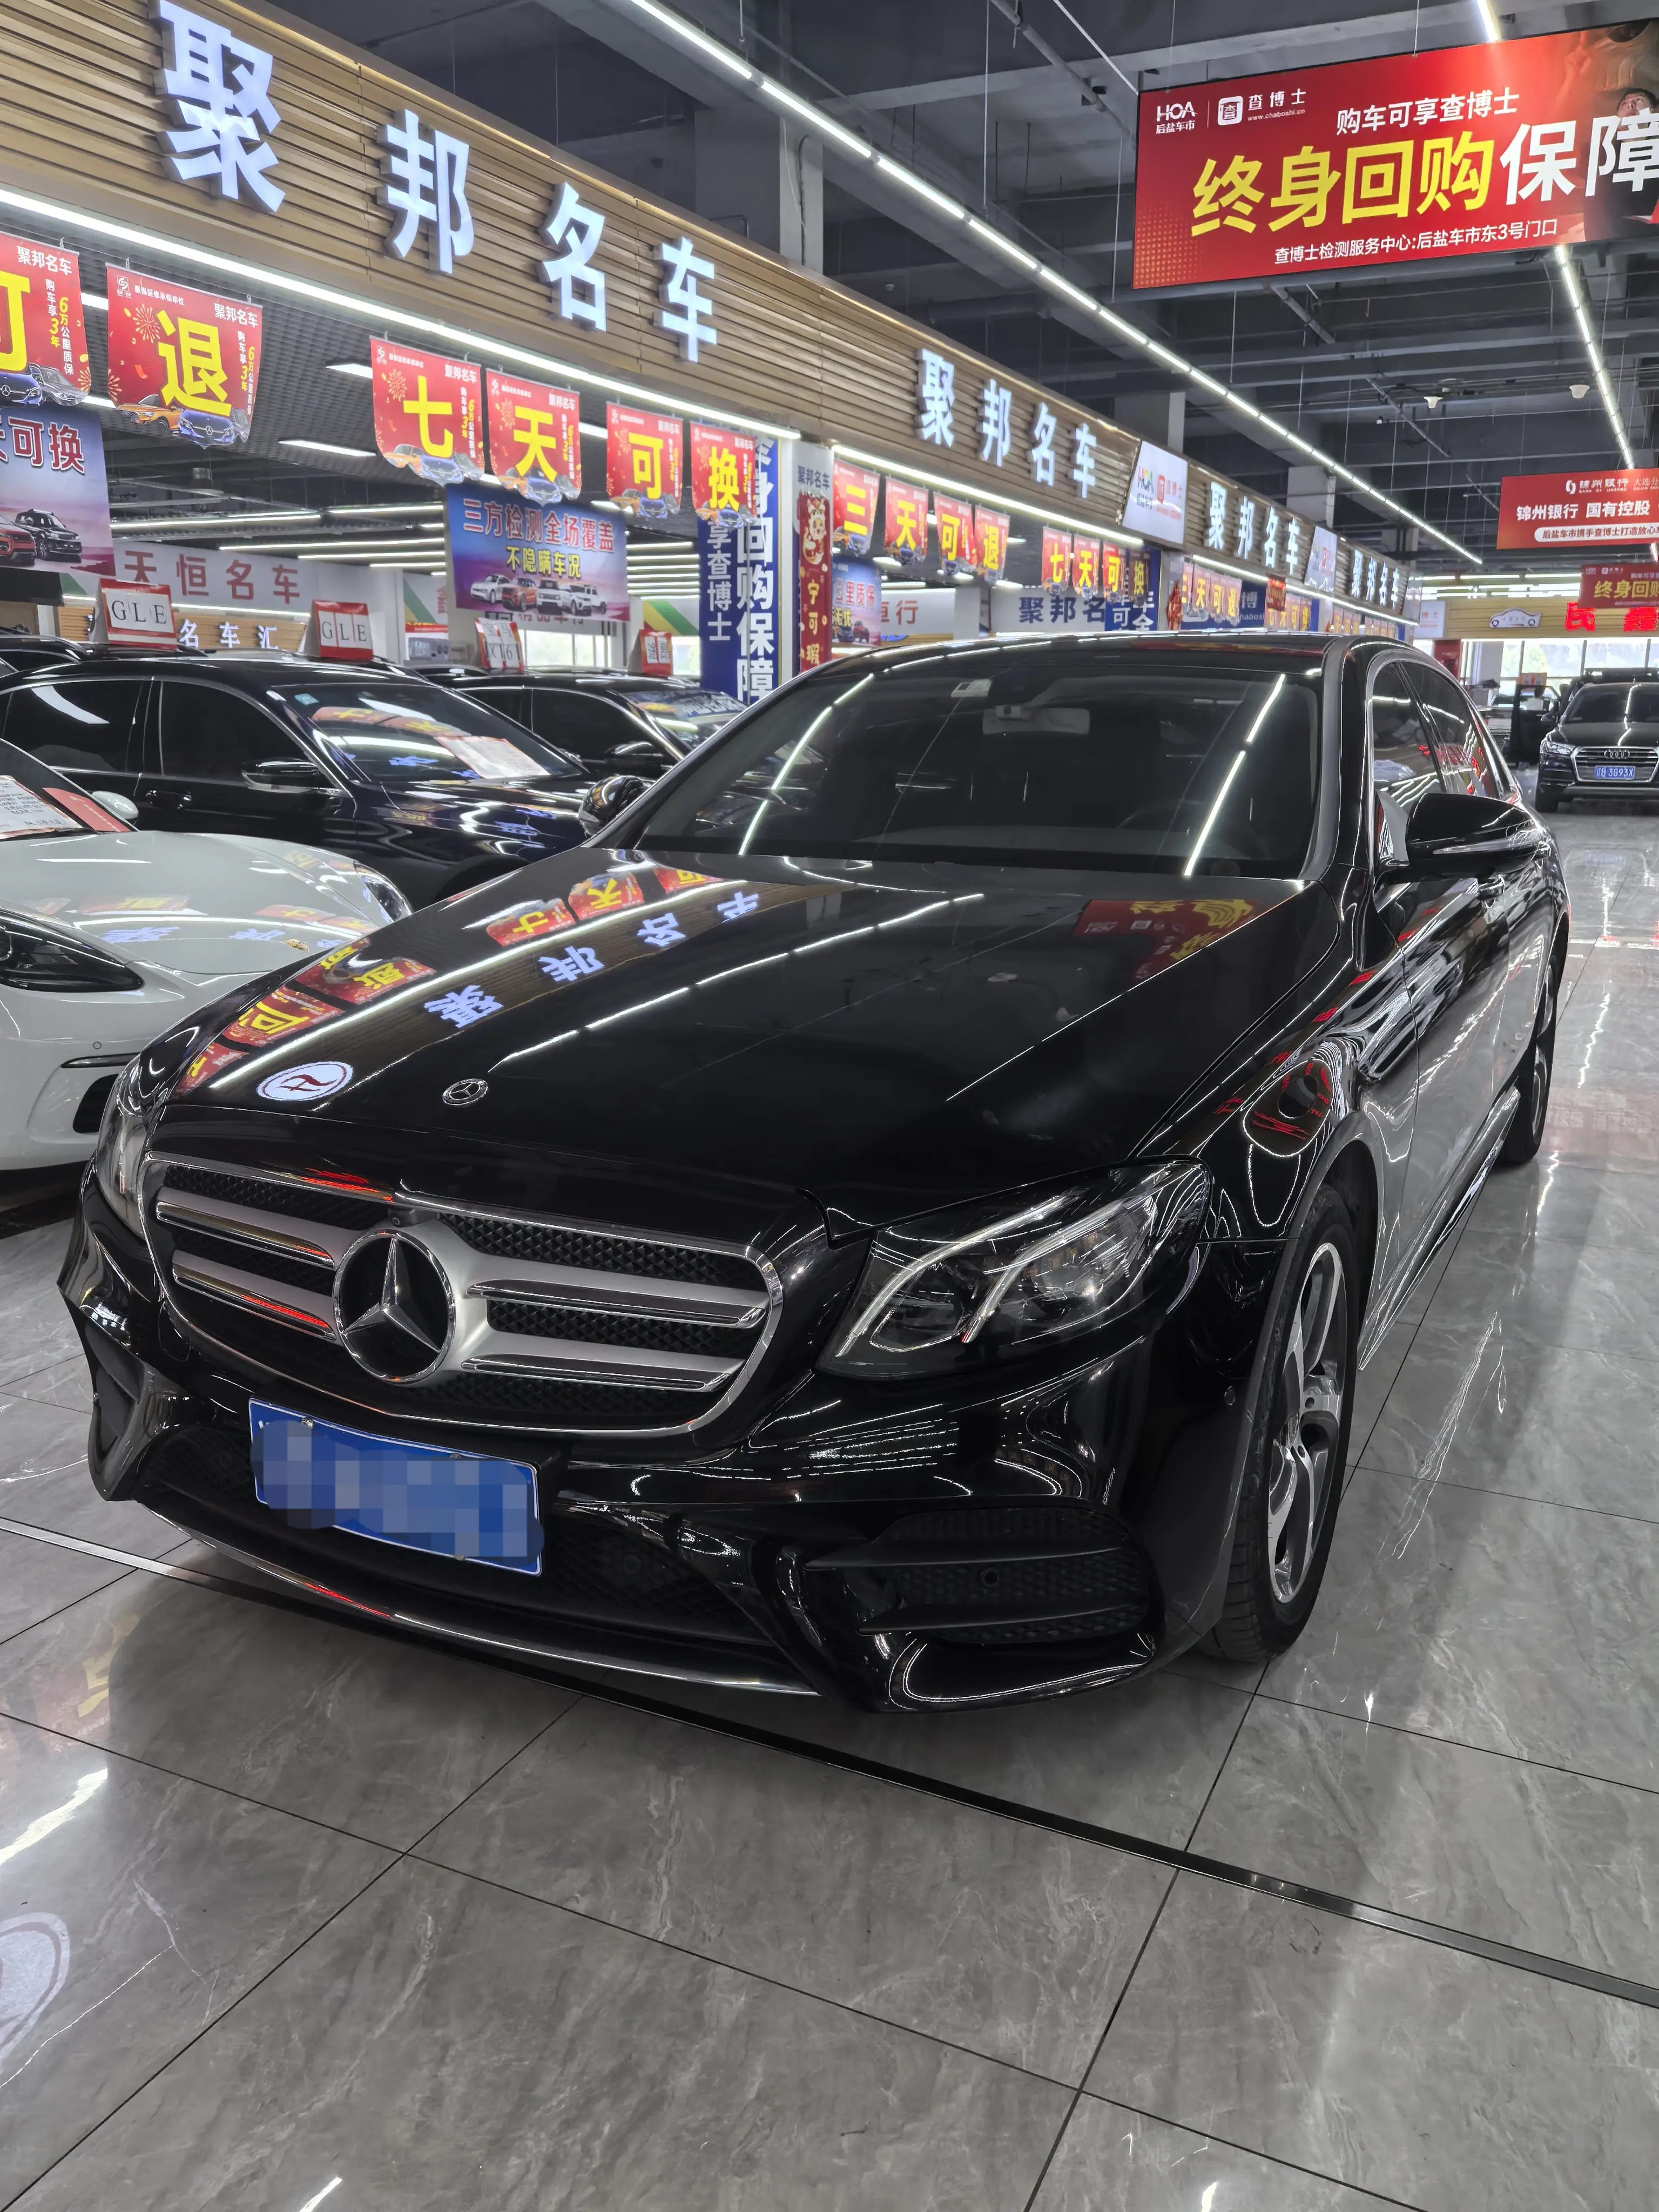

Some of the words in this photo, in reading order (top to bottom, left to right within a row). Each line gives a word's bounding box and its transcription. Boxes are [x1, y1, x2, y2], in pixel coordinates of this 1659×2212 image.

[1247, 88, 1306, 111] 查博士
[1337, 87, 1519, 135] 购车可享查博士
[1156, 120, 1196, 135] 后盐车市
[159, 0, 717, 363] 聚邦名车
[1191, 108, 1659, 237] 终身回购保障
[17, 245, 73, 276] 聚邦名车
[1274, 219, 1557, 264] 查博士检测服务中心:后盐车市东3号门口
[45, 278, 60, 348] 购车享3年
[59, 296, 74, 375] 6万公里质保
[214, 302, 258, 328] 聚邦名车
[157, 309, 232, 416] 退
[403, 375, 454, 458] 七
[921, 348, 1097, 500] 聚邦名车
[514, 406, 558, 483] 天
[628, 432, 664, 500] 可
[709, 446, 739, 512] 换
[463, 497, 615, 553] 三方检测全场覆盖
[844, 484, 868, 536] 三
[896, 500, 916, 551] 天
[1208, 481, 1301, 576] 聚邦名车
[1516, 503, 1579, 521] 锦州银行
[1586, 500, 1650, 518] 国有控股
[505, 545, 582, 578] 不隐瞒车况
[941, 514, 960, 562] 可
[983, 523, 999, 571] 退
[124, 550, 300, 604] 天恒名车
[1049, 542, 1064, 583] 七
[1078, 550, 1092, 589] 天
[1108, 556, 1121, 592] 可
[111, 599, 167, 625] GLE
[1196, 578, 1206, 610] 天
[1213, 584, 1222, 614] 可
[179, 618, 279, 650] 名车汇
[322, 620, 367, 643] GLE
